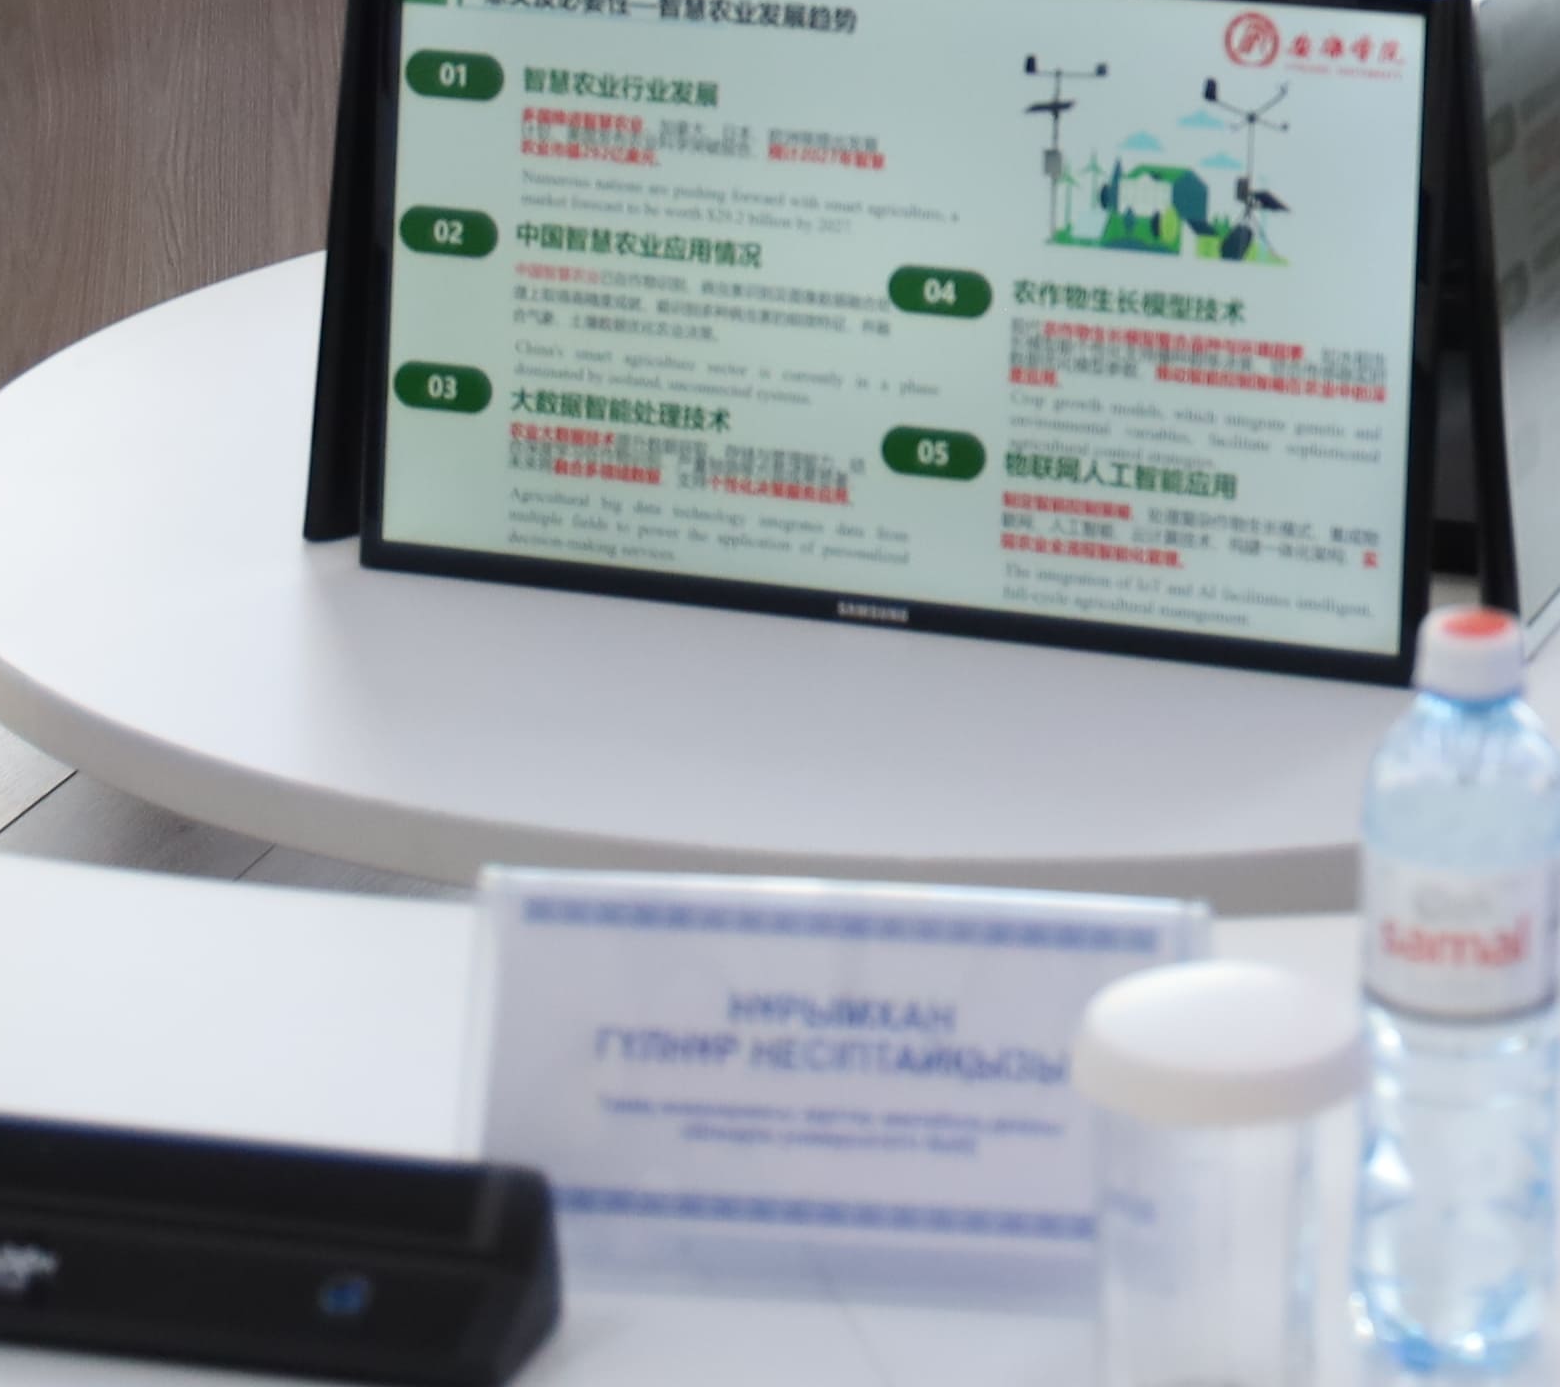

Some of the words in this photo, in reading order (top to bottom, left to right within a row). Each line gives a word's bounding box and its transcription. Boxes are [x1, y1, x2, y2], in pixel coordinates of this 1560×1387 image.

[438, 60, 467, 88] 01
[523, 64, 719, 108] 智慧农业行业发展
[432, 218, 463, 245] 02
[515, 220, 762, 269] 中国智慧农业应用情况
[923, 276, 957, 306] 04
[1013, 278, 1245, 326] 农作物生长模型技术
[426, 372, 458, 400] 03
[510, 386, 731, 433] 大数据智能处理技术
[916, 437, 950, 467] 05
[1004, 449, 1238, 500] 物联网人工智能应用
[1380, 911, 1533, 969] samal
